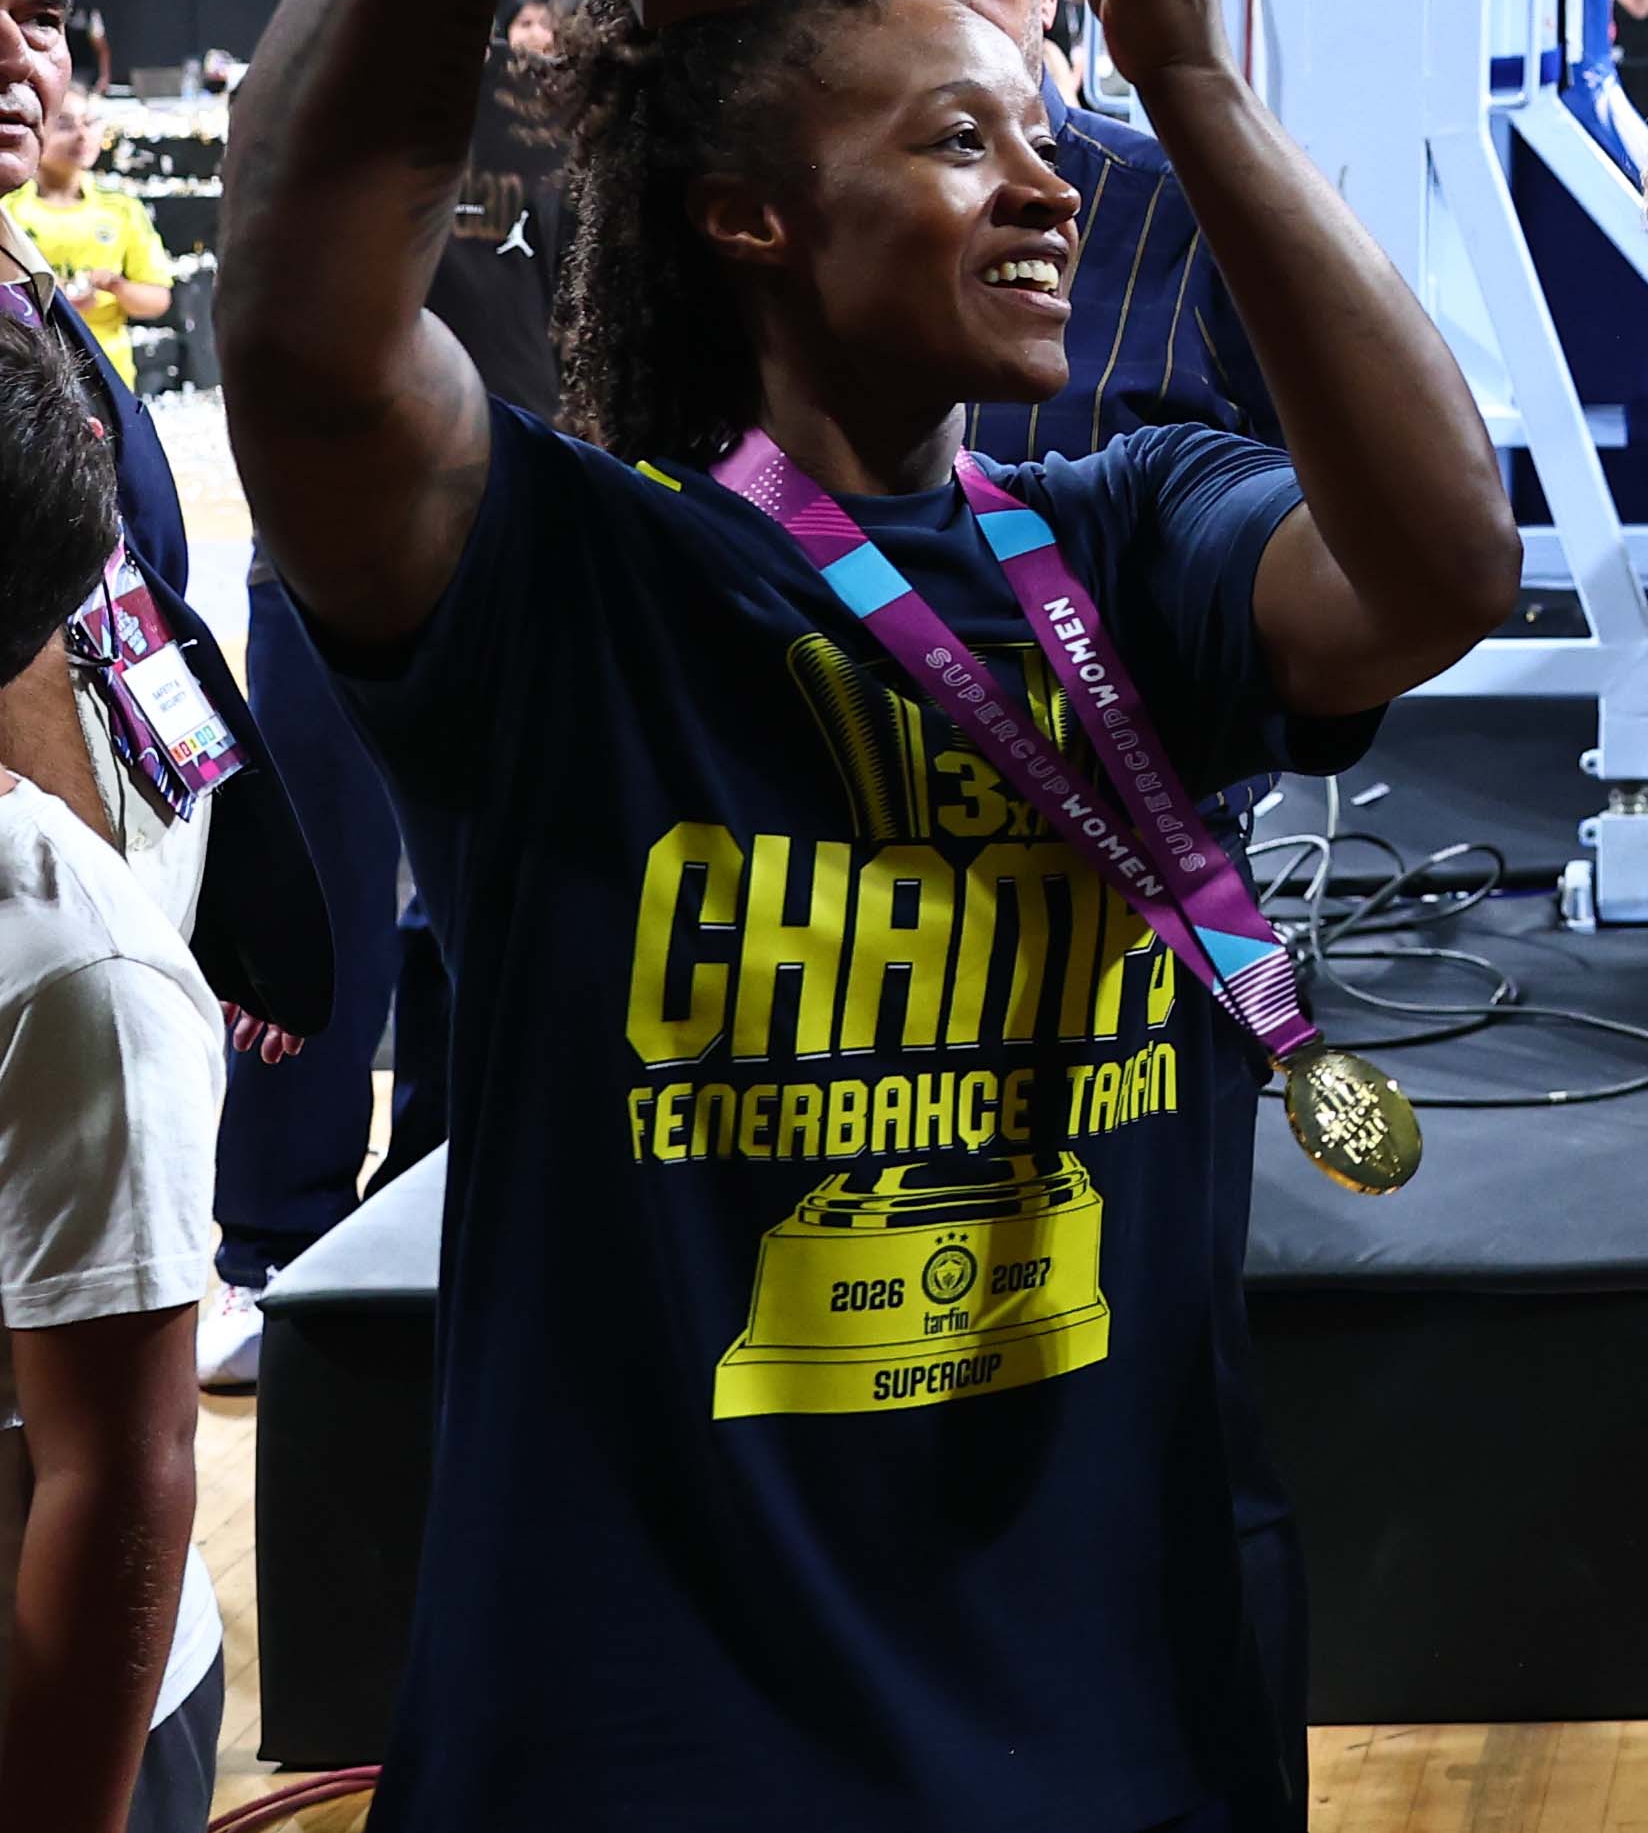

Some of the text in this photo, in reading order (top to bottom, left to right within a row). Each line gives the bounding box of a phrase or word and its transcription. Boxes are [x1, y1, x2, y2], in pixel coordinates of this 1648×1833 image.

[831, 1278, 904, 1312] 2026
[992, 1257, 1052, 1295] 2027
[923, 1307, 969, 1335] tarfin
[873, 1354, 1003, 1400] SUPERCUP
